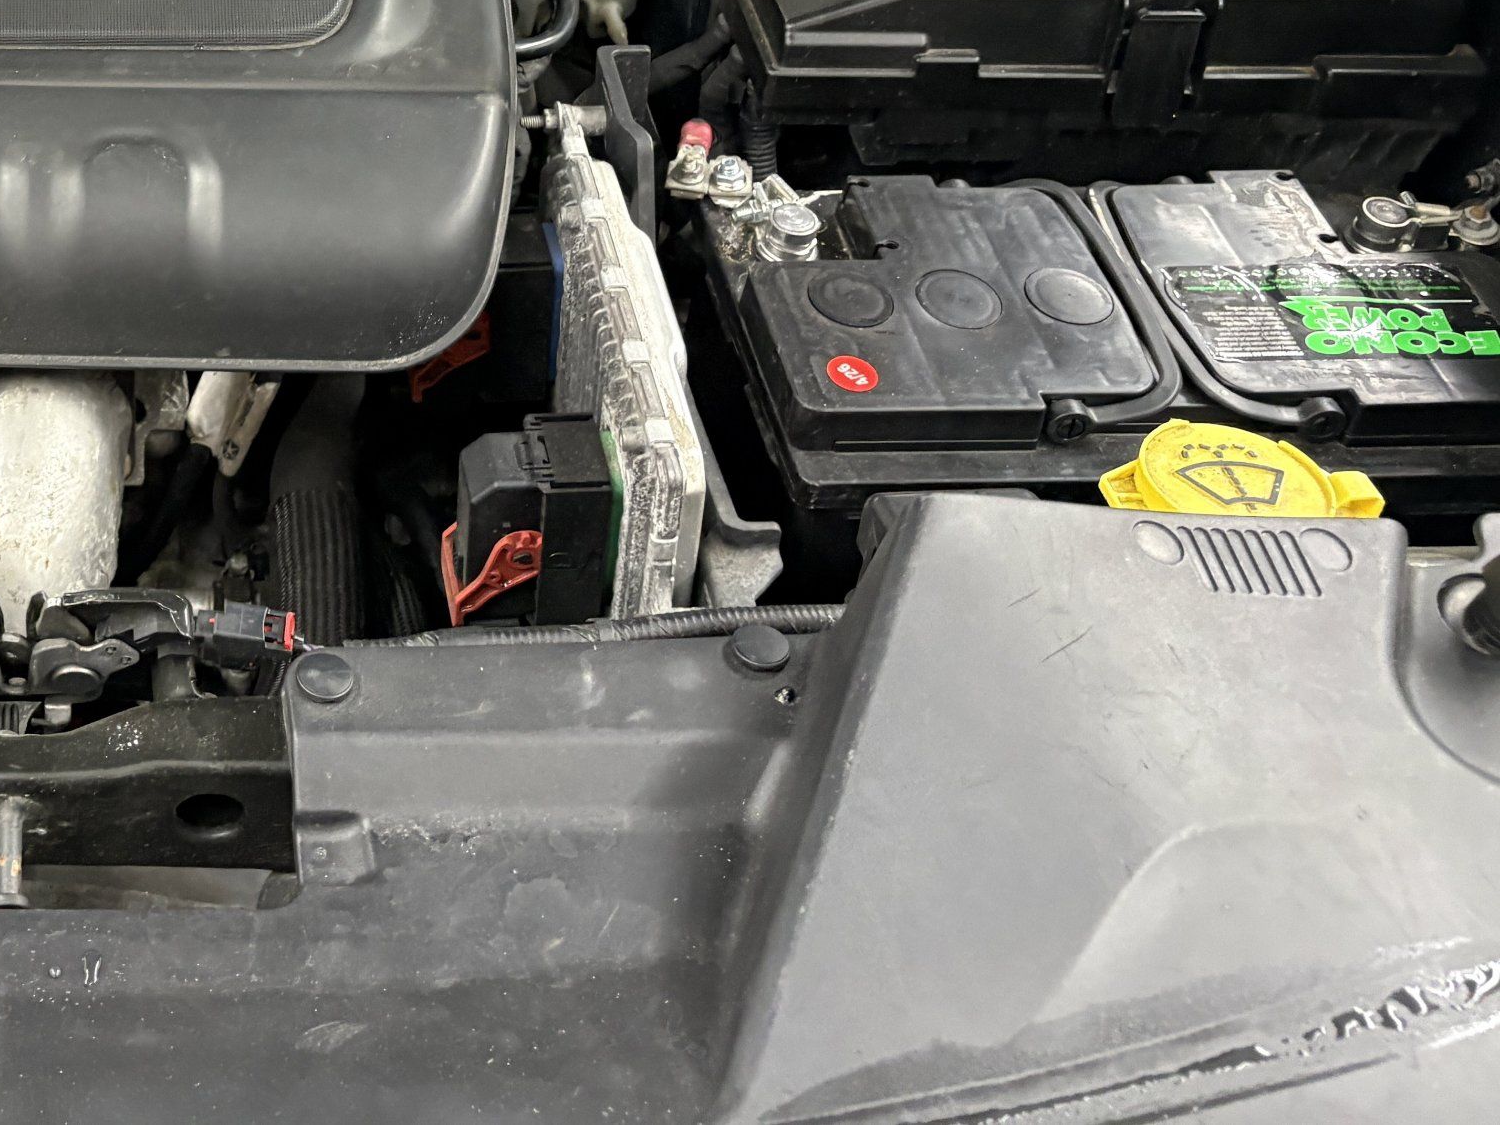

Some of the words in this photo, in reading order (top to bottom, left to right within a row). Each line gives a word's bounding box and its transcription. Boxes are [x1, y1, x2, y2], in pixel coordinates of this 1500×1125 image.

[1302, 306, 1454, 332] POWER
[1304, 329, 1500, 356] ECONO
[836, 362, 869, 386] 4/26
